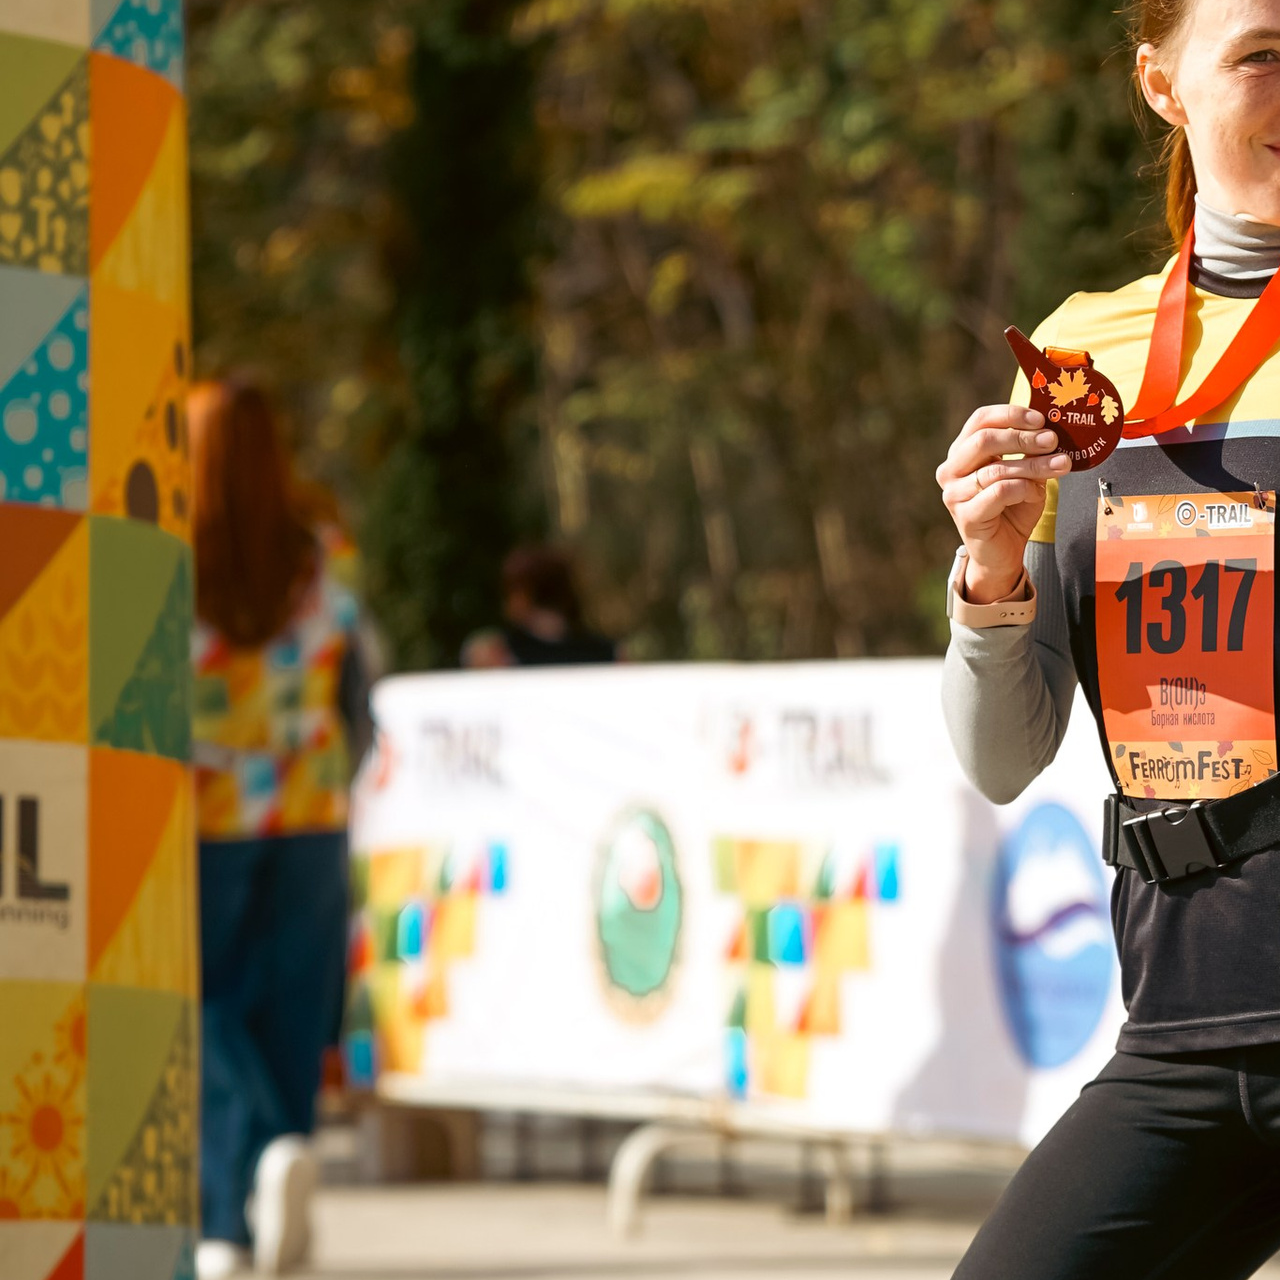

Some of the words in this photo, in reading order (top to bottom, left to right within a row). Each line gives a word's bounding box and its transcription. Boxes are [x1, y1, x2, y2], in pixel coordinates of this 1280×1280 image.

[1115, 558, 1257, 654] 1317
[1151, 709, 1179, 729] Борная
[1183, 712, 1216, 726] кислота
